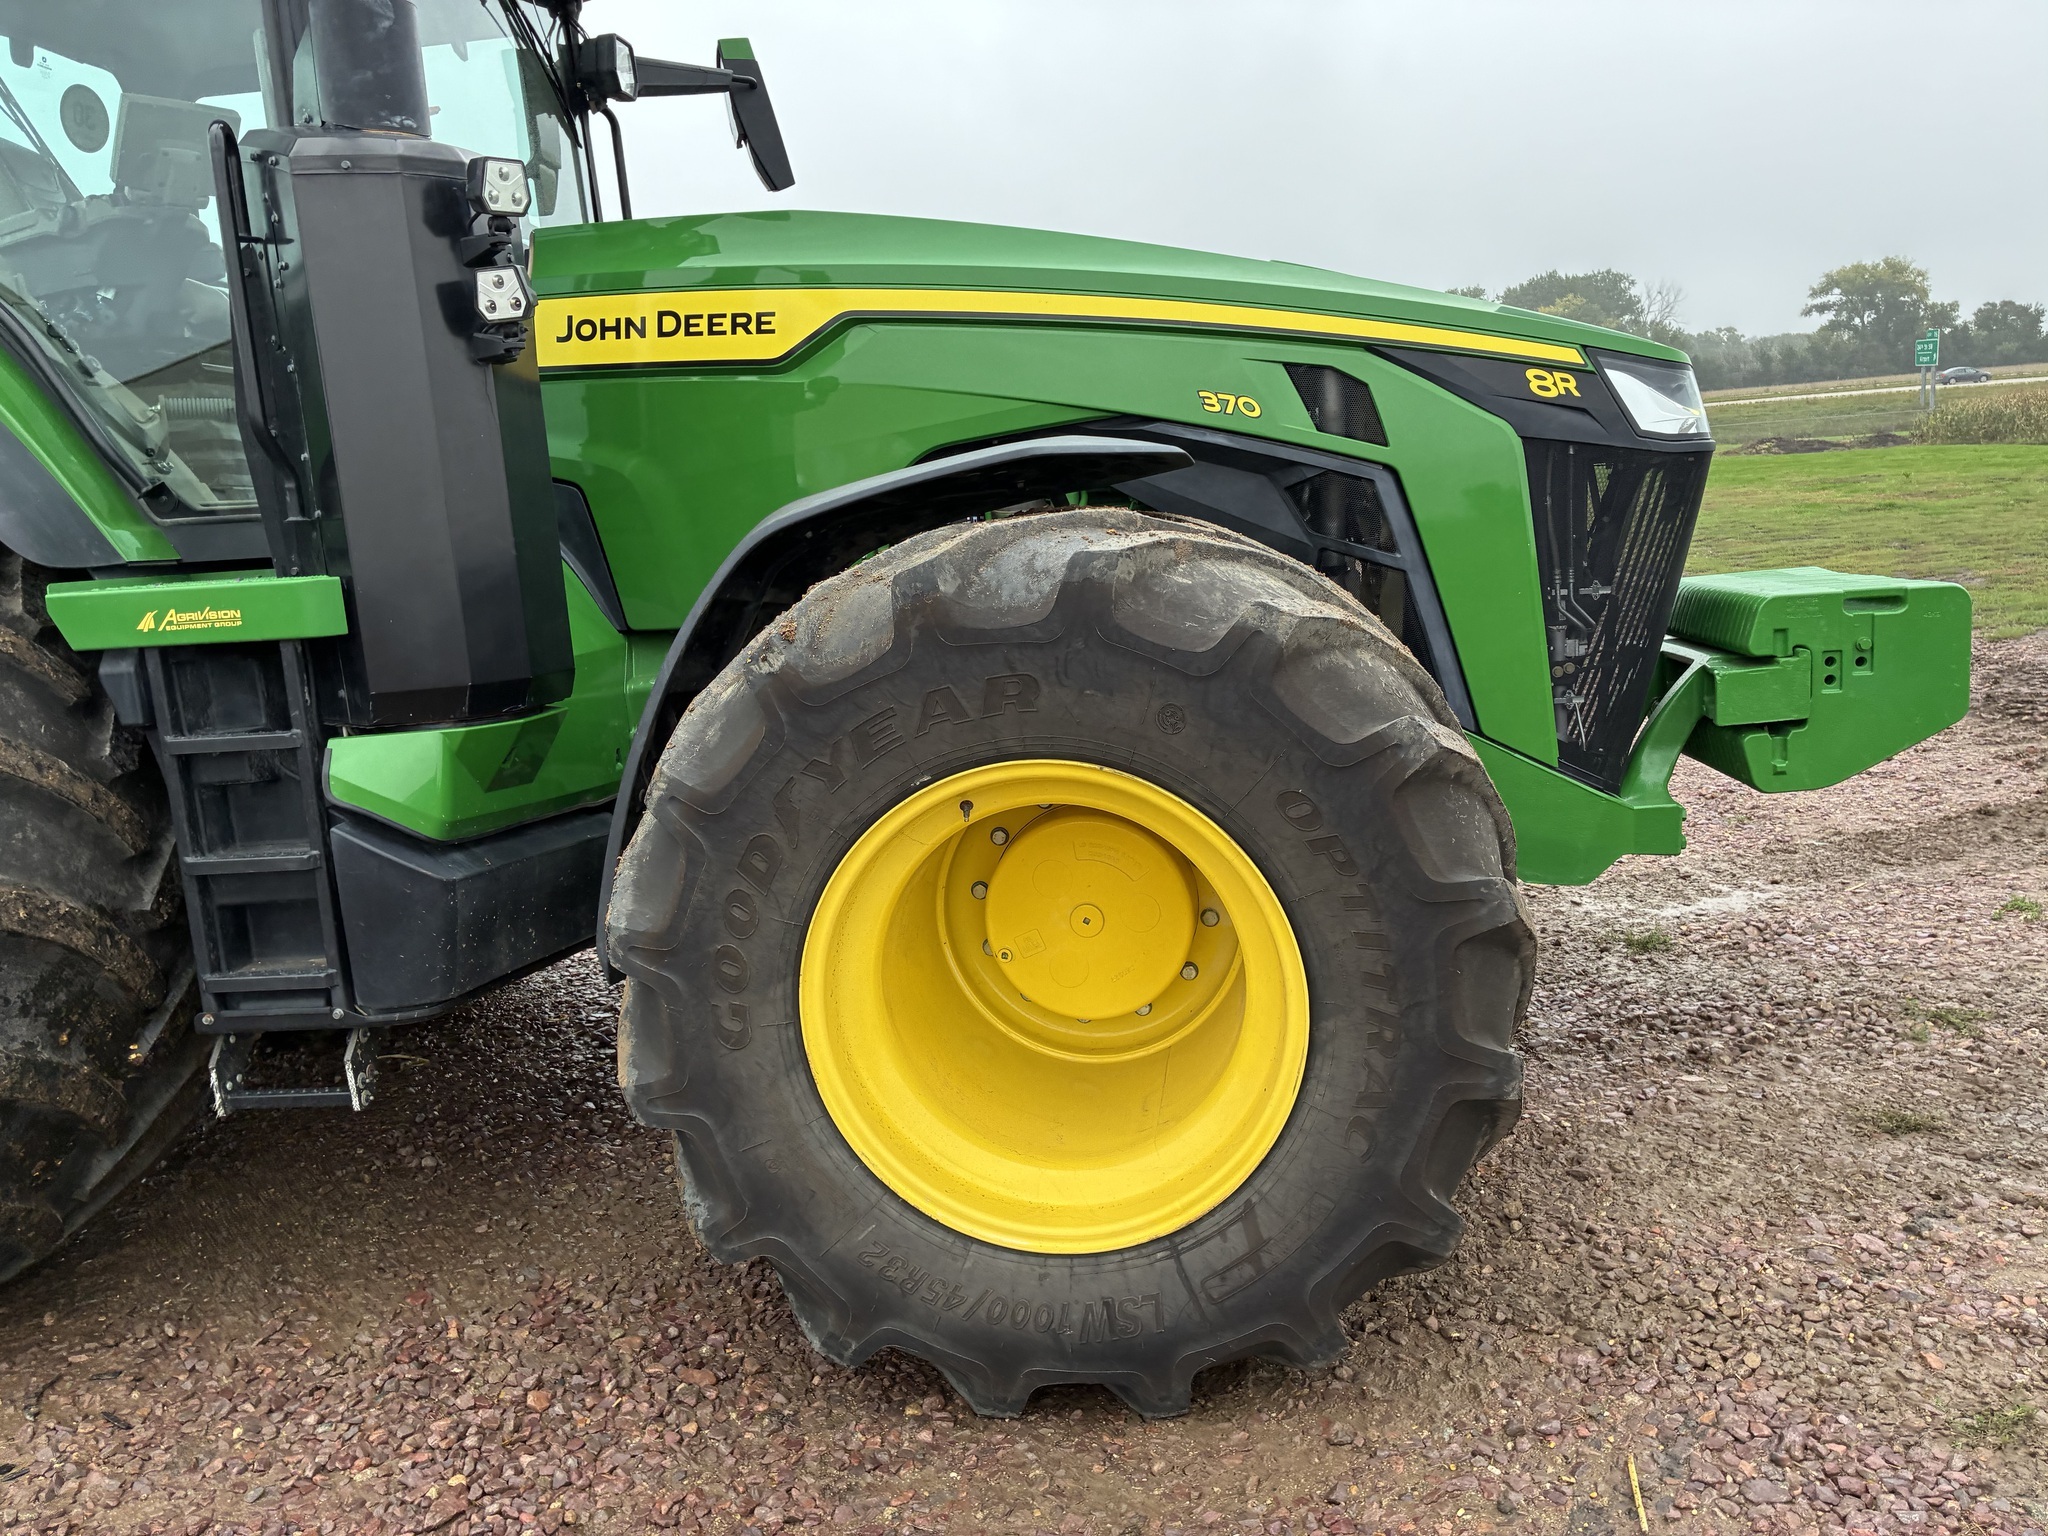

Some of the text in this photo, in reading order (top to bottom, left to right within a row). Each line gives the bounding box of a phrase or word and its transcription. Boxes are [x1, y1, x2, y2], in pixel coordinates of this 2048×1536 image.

[556, 310, 776, 343] JOHN DEERE
[1525, 368, 1581, 398] 8R
[1197, 390, 1262, 419] 370
[165, 623, 213, 632] EQUIPMENT
